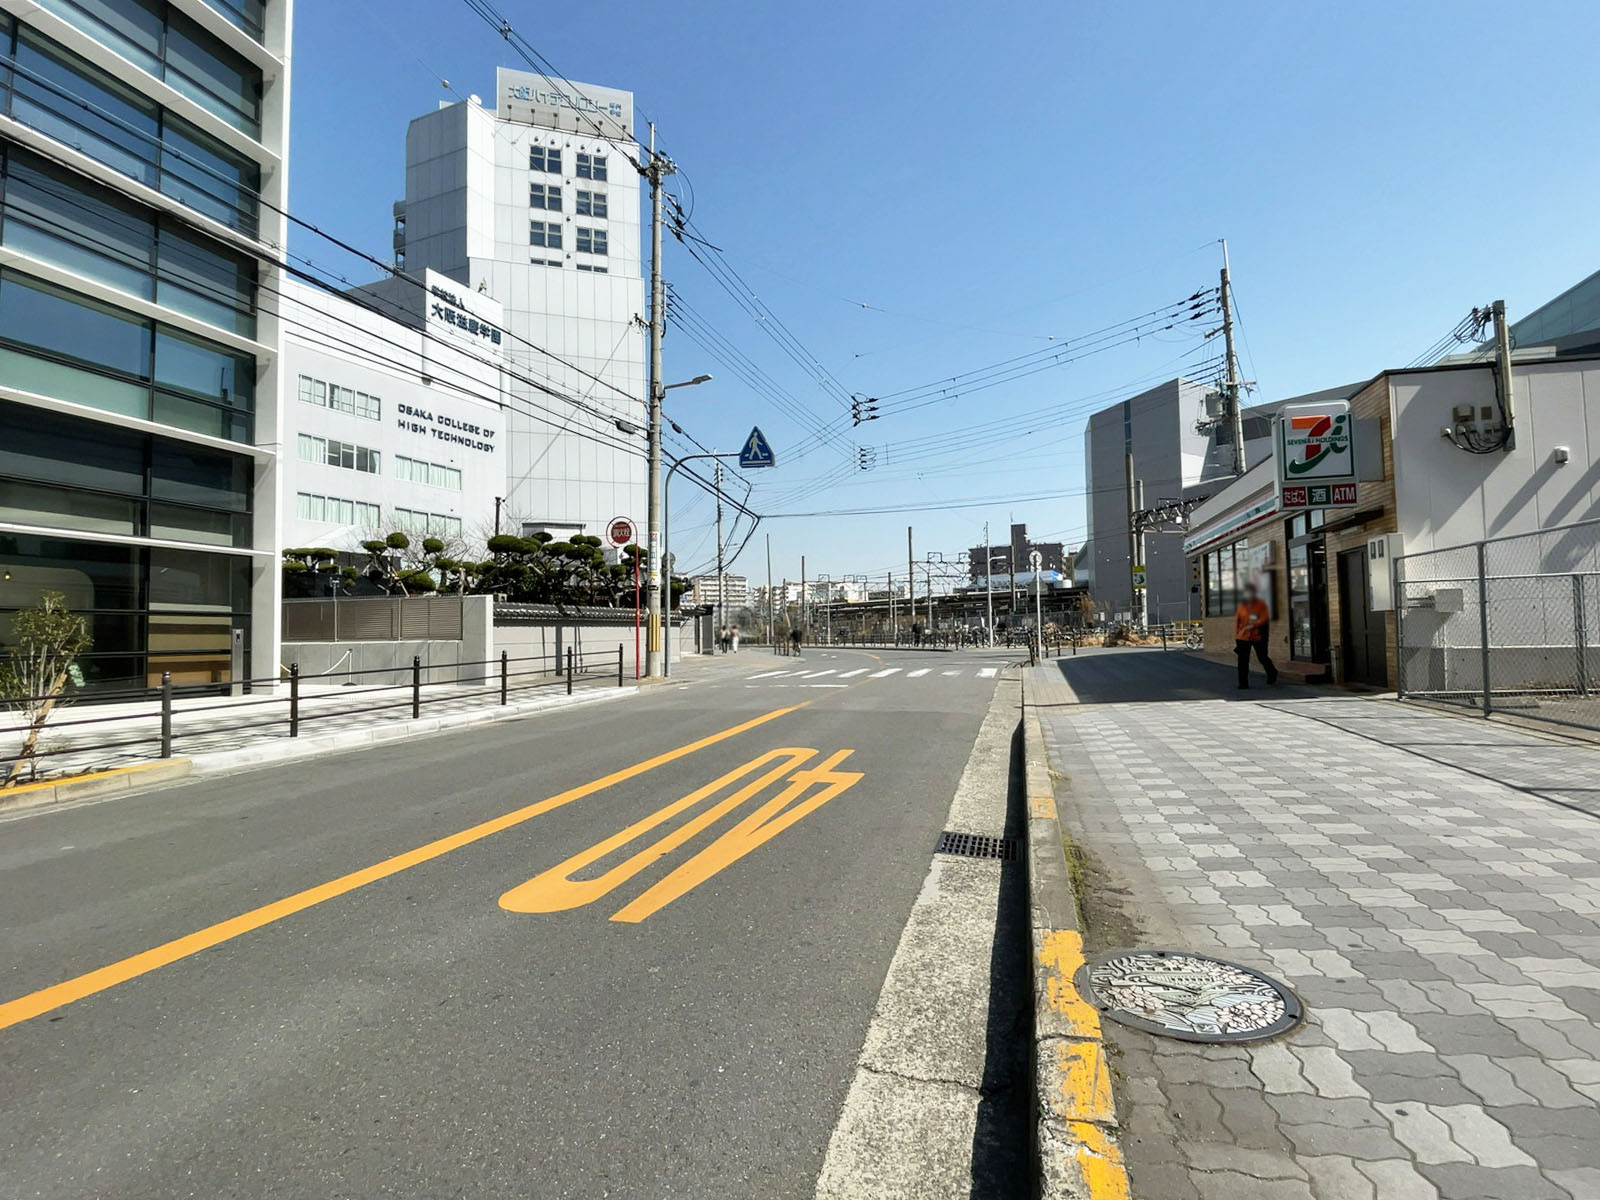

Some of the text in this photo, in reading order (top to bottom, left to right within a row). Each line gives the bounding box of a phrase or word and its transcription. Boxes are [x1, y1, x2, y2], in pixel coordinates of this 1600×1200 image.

[397, 403, 495, 439] OSAKA COLLEGE OF
[397, 419, 495, 453] HIGH TECHNOLOGY
[1283, 489, 1306, 504] たばこ
[1311, 488, 1327, 503] 酒
[1334, 487, 1356, 501] ATM
